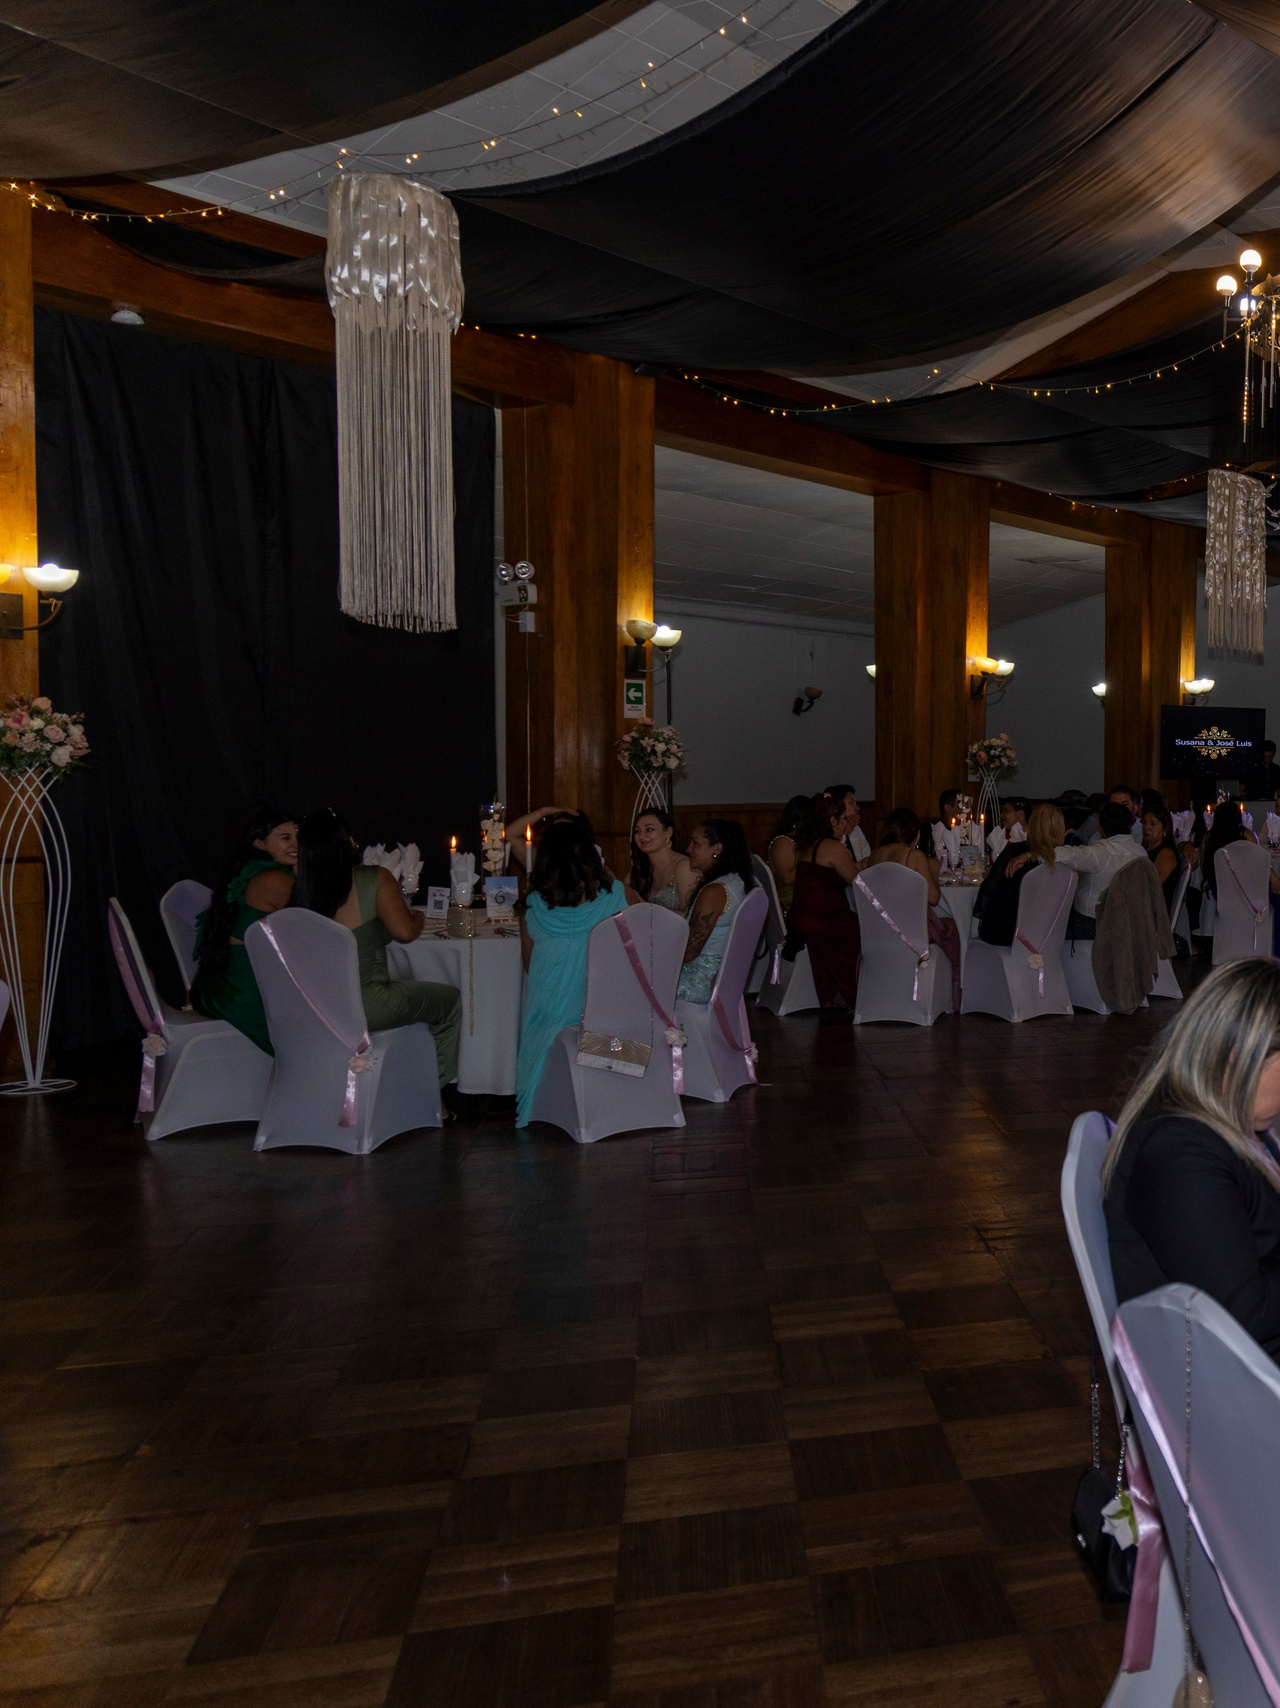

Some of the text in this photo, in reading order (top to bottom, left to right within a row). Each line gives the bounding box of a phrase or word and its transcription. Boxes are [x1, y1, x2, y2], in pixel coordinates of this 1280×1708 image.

[1175, 738, 1205, 746] Susana
[1215, 739, 1235, 747] José
[1236, 740, 1253, 748] Luis
[494, 890, 506, 905] 6
